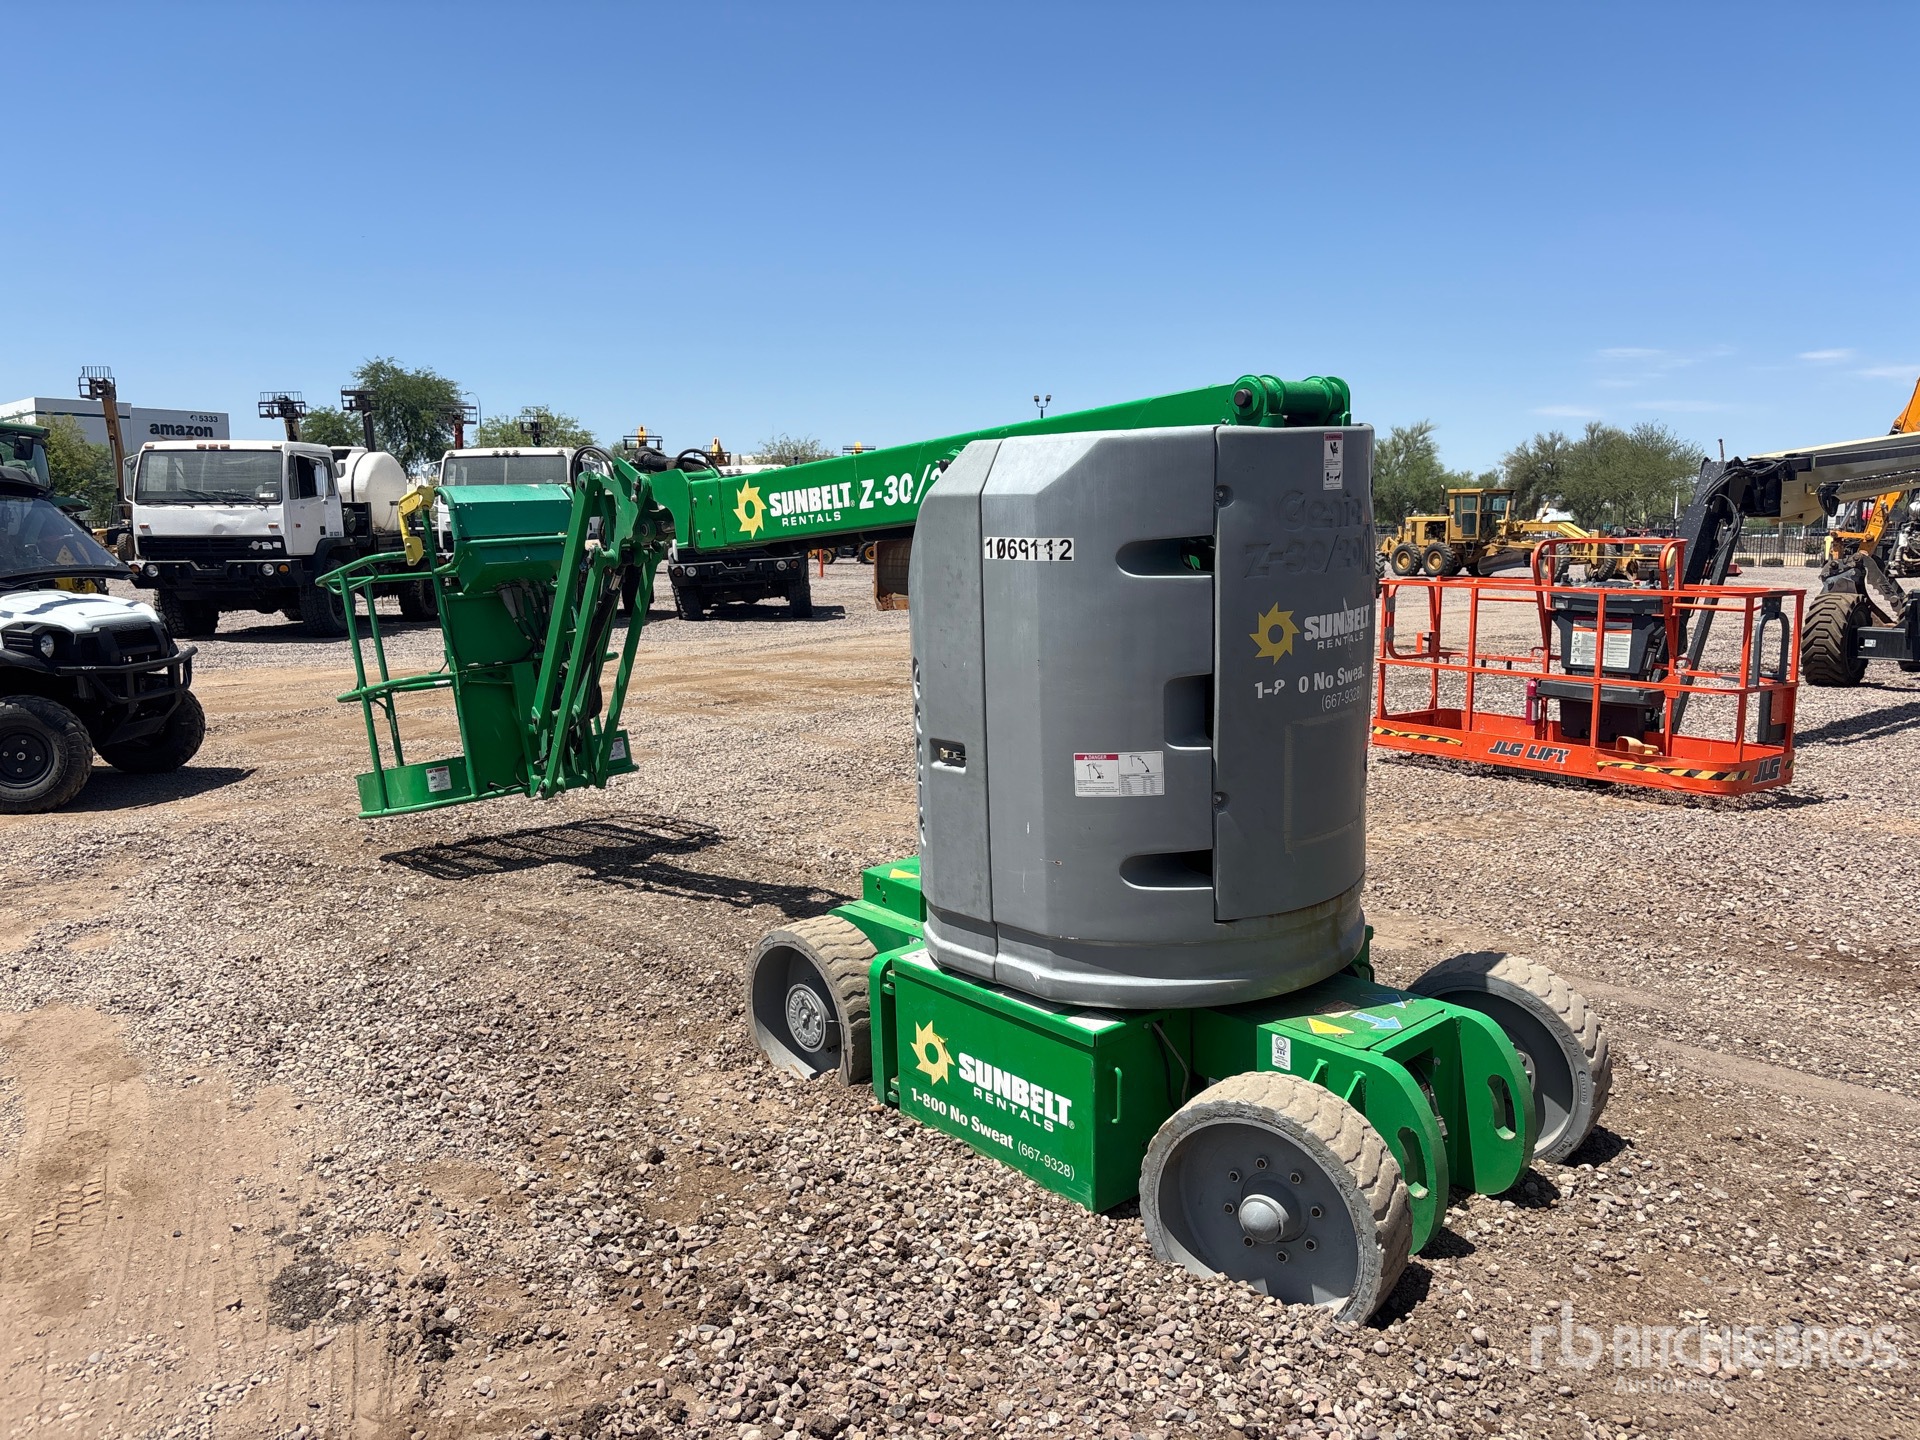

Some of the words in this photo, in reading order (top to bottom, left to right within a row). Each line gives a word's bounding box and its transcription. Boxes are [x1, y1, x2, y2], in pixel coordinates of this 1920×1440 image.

[149, 423, 214, 438] amazon
[198, 415, 219, 423] 5333
[768, 481, 851, 517] SUNBELT
[781, 511, 842, 528] RENTALS
[985, 537, 1073, 561] 1069112
[1303, 604, 1370, 641] SUNBELT
[1317, 631, 1364, 651] RENTALS
[1313, 671, 1334, 691] No
[1337, 662, 1366, 686] Swea
[1487, 740, 1525, 758] JLG
[1525, 744, 1571, 765] LIFT
[1751, 756, 1782, 786] JLG
[958, 1052, 1072, 1127] SUNBELT
[973, 1086, 1054, 1132] RENTALS
[911, 1087, 947, 1115] 1-800
[949, 1104, 968, 1126] No
[971, 1115, 1014, 1150] Sweat
[1017, 1140, 1075, 1181] (667-9328)
